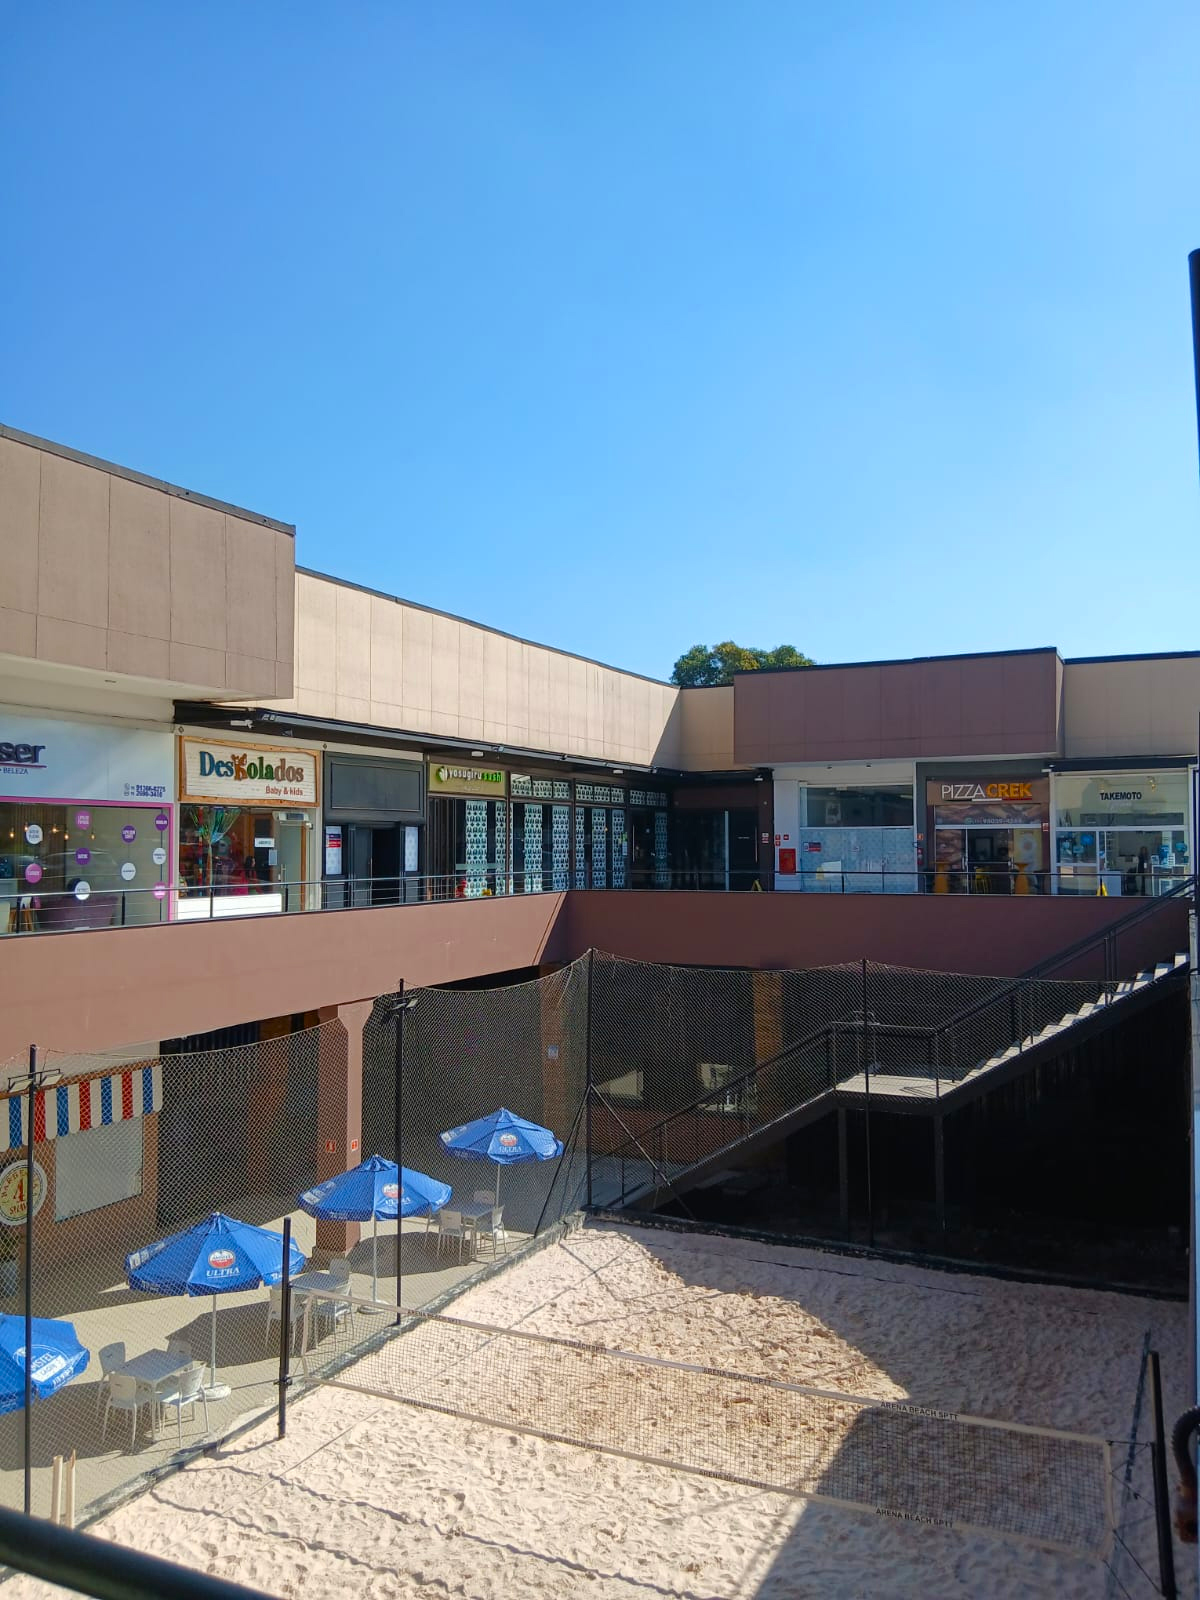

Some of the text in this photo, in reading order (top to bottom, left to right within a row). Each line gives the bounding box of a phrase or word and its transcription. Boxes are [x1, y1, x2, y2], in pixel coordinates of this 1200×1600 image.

[265, 785, 282, 796] Baby
[283, 787, 289, 795] &
[941, 783, 1032, 799] PIZZA CREK
[1099, 791, 1142, 801] TAKEMOTO
[206, 1264, 240, 1277] ULTRA
[880, 1402, 907, 1411] ARENA
